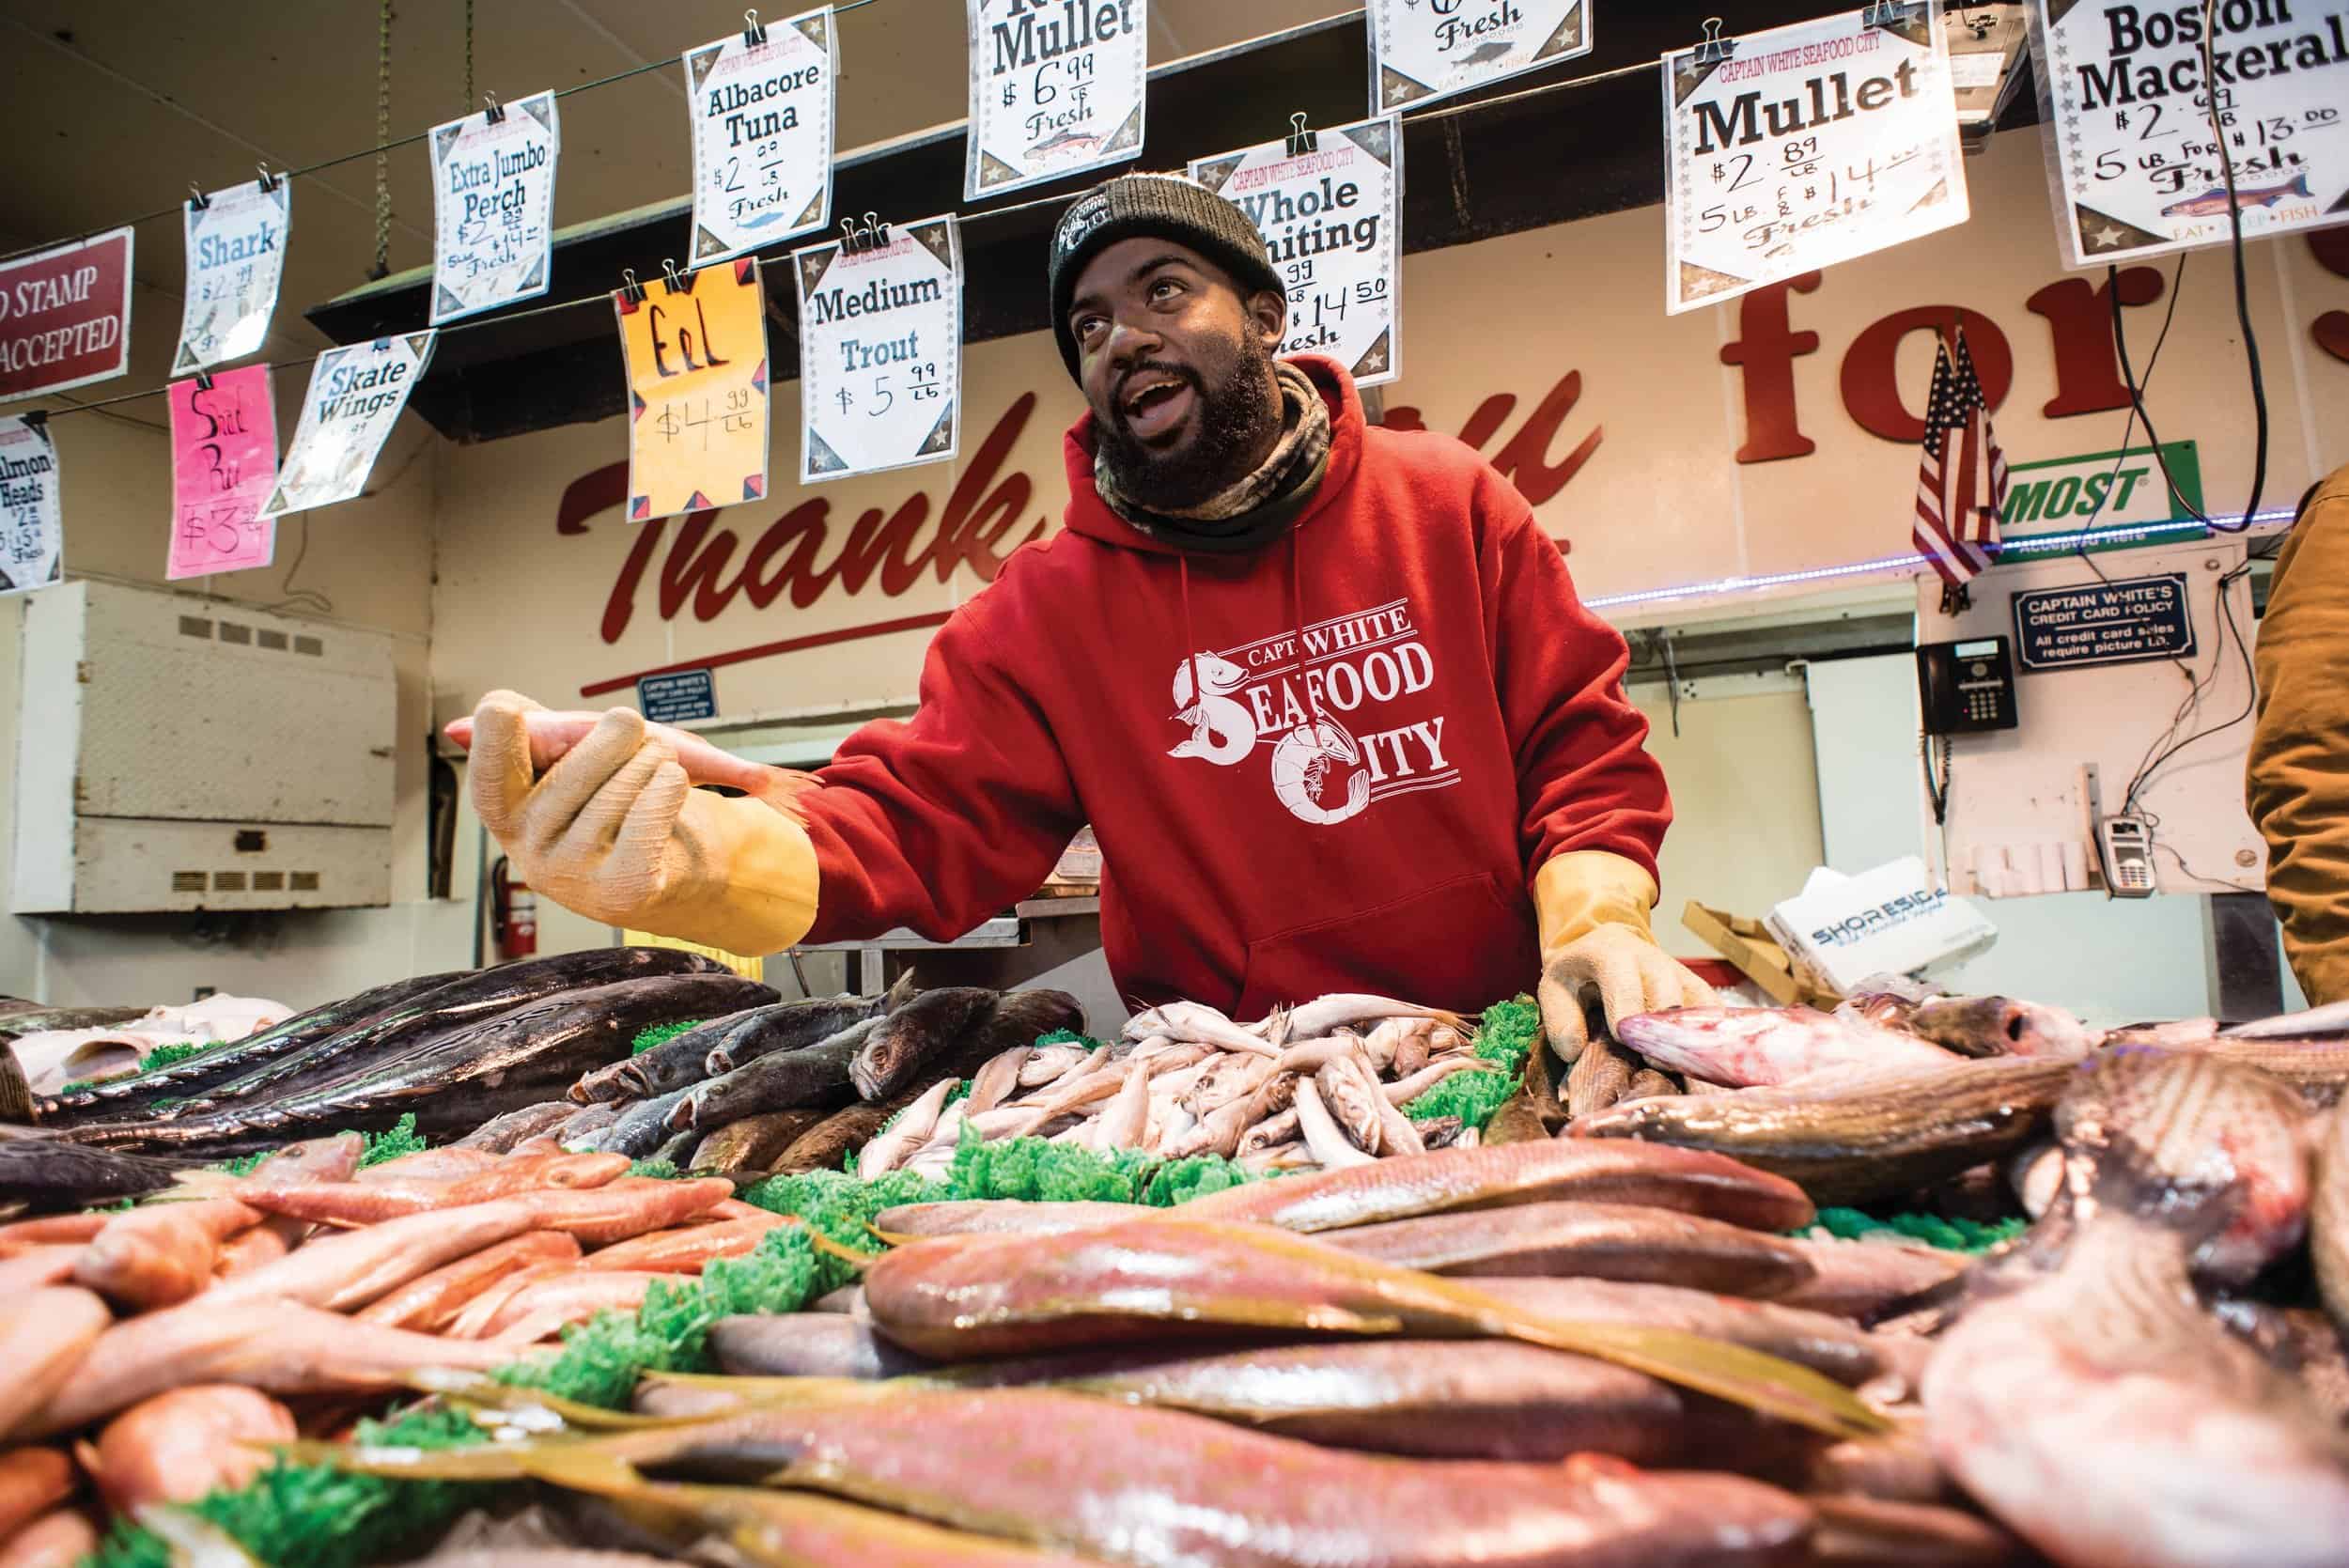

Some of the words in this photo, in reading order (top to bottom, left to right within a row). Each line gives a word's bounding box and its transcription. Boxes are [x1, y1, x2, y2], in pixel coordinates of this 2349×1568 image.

[992, 0, 1134, 76] Mullet
[1435, 0, 1524, 52] Fresh
[1719, 59, 1766, 84] CAPTAIN
[1766, 51, 1802, 74] WHITE
[1803, 38, 1854, 67] SEAFOOD
[1855, 31, 1881, 54] CITY
[2077, 14, 2349, 111] Mackeral
[708, 65, 820, 118] Albacore
[1692, 57, 1919, 156] Mullet
[726, 105, 800, 148] Tuna
[1025, 93, 1093, 141] Fresh
[450, 160, 490, 194] Extra
[493, 140, 546, 189] Jumbo
[1233, 163, 1268, 192] CAPTAIN
[1268, 159, 1295, 185] WHITE
[1295, 150, 1336, 180] SEAFOOD
[1336, 146, 1356, 169] CITY
[464, 179, 526, 225] Perch
[729, 187, 790, 220] Fresh
[1233, 177, 1359, 229] Whole
[198, 221, 277, 270] Shark
[1264, 212, 1380, 265] hiting
[13, 266, 99, 318] STAMP
[814, 276, 942, 325] Medium
[0, 315, 118, 373] ACCEPTED
[841, 330, 919, 372] Trout
[1280, 325, 1341, 354] resh
[329, 360, 407, 397] Skate
[318, 389, 399, 425] Wings
[557, 391, 1047, 644] Thank
[1719, 266, 2165, 464] for
[2, 477, 44, 508] Heads
[1999, 467, 2150, 525] MOST
[2029, 593, 2097, 612] CAPTAIN
[2103, 585, 2173, 603] WHITE'S
[2030, 612, 2077, 626] CREDIT
[2082, 606, 2120, 619] CARD
[1302, 607, 1411, 657] WHITE
[2035, 634, 2051, 647] All
[2057, 630, 2096, 644] credit
[2102, 627, 2133, 640] card
[2043, 644, 2090, 659] require
[2094, 641, 2143, 655] picture
